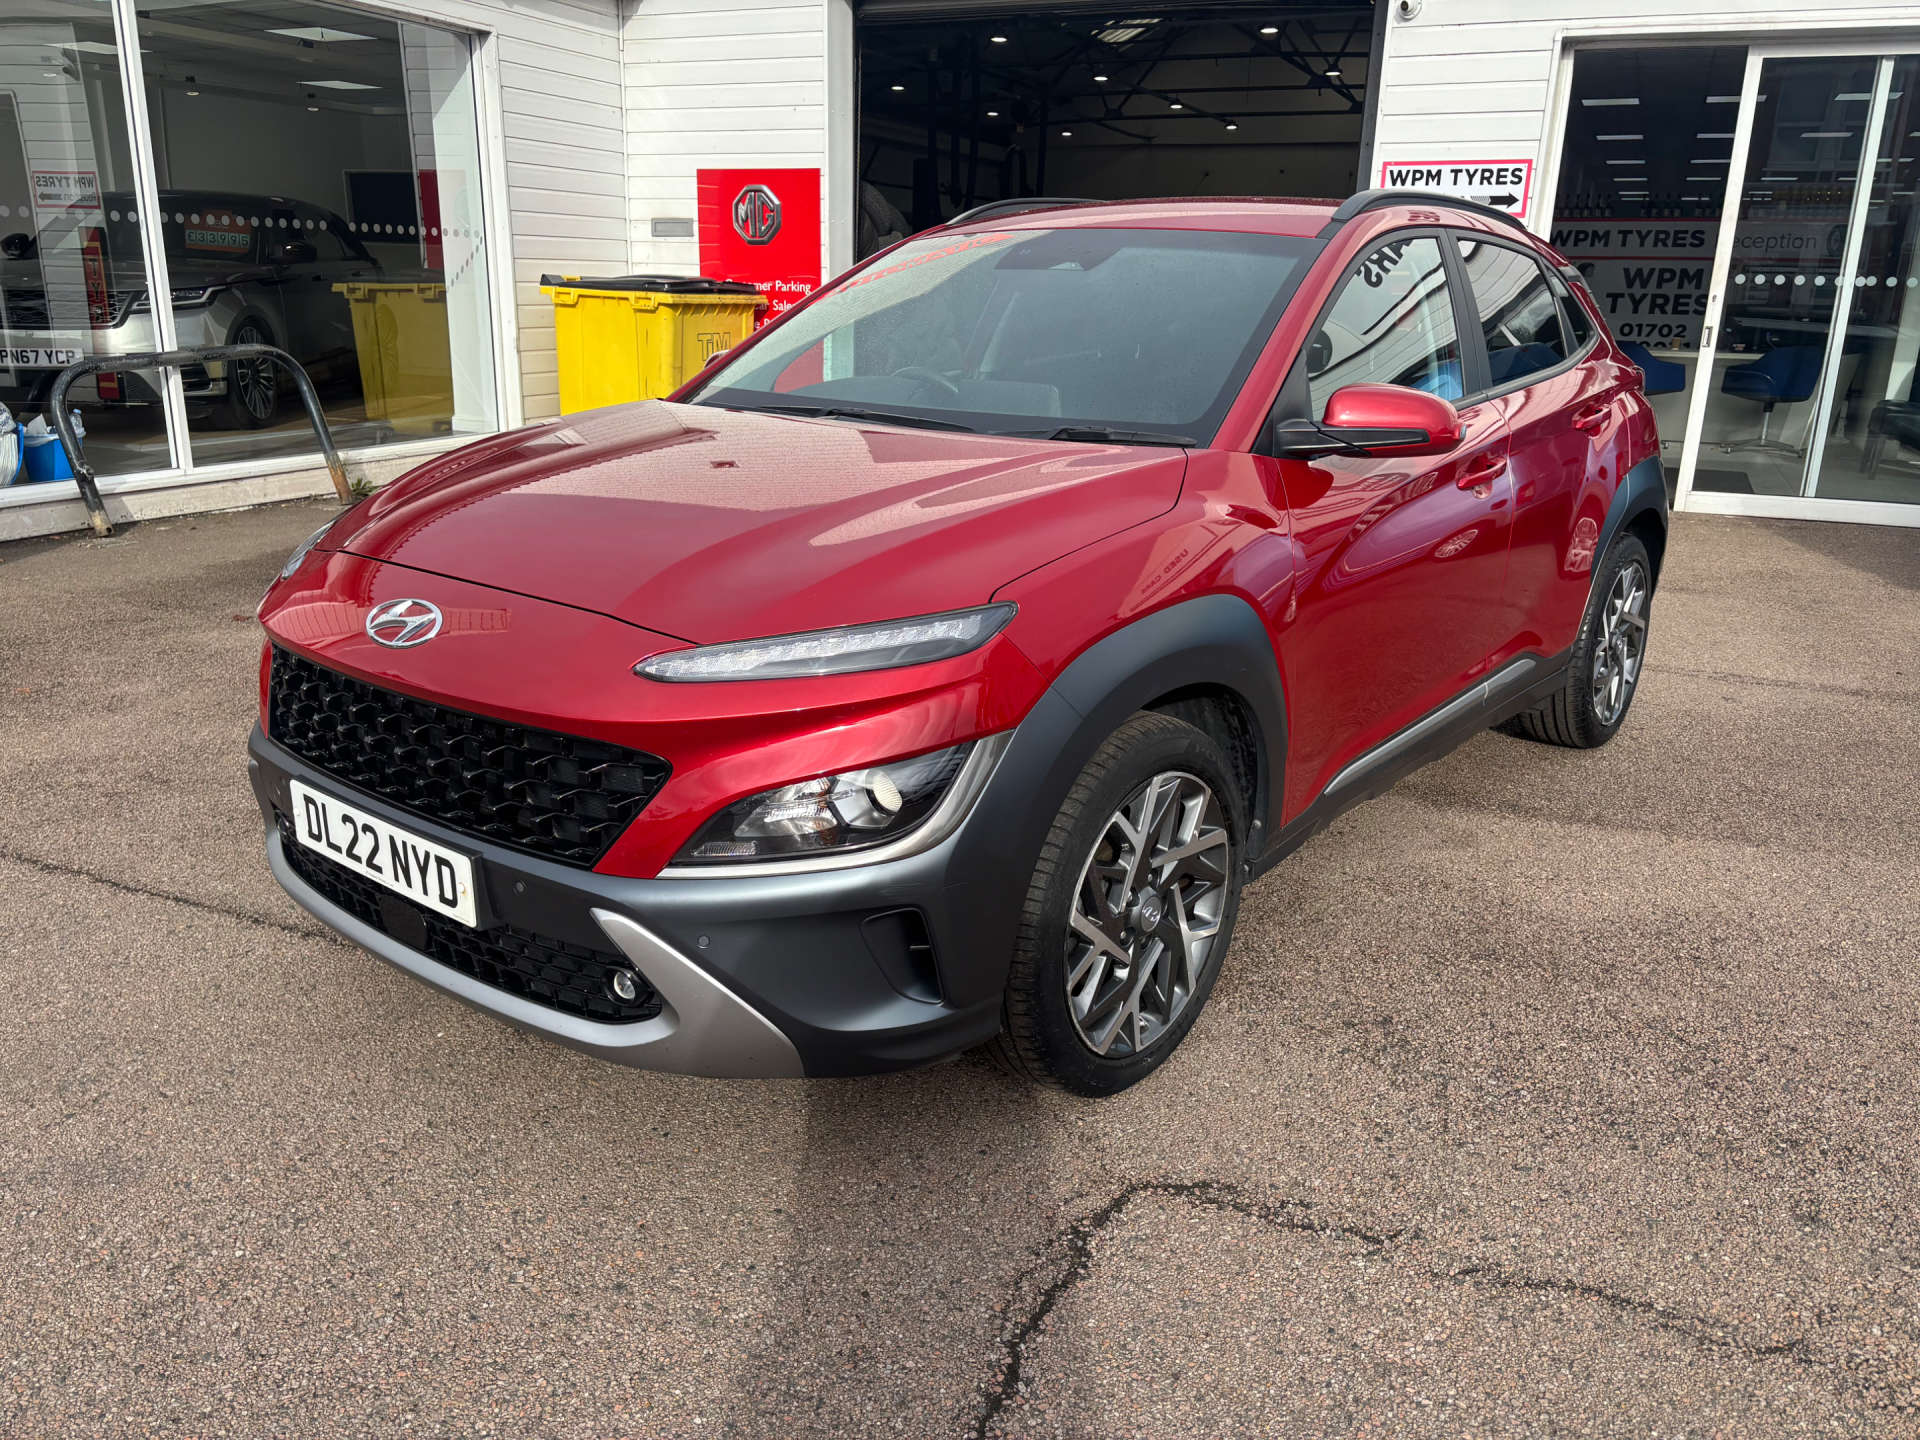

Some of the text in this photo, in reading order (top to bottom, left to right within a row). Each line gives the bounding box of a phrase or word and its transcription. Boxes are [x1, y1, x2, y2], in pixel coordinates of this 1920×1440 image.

[1389, 167, 1524, 187] WPM TYRES
[737, 190, 776, 239] MG
[1550, 229, 1818, 254] WPM TYRES eception
[775, 279, 812, 297] Parking
[1623, 267, 1705, 290] WPM
[772, 299, 794, 311] Sale
[1605, 292, 1709, 316] TYRES
[1619, 322, 1688, 338] 01702
[0, 349, 76, 365] PN67 YCP
[303, 793, 458, 909] DL22 NYD
